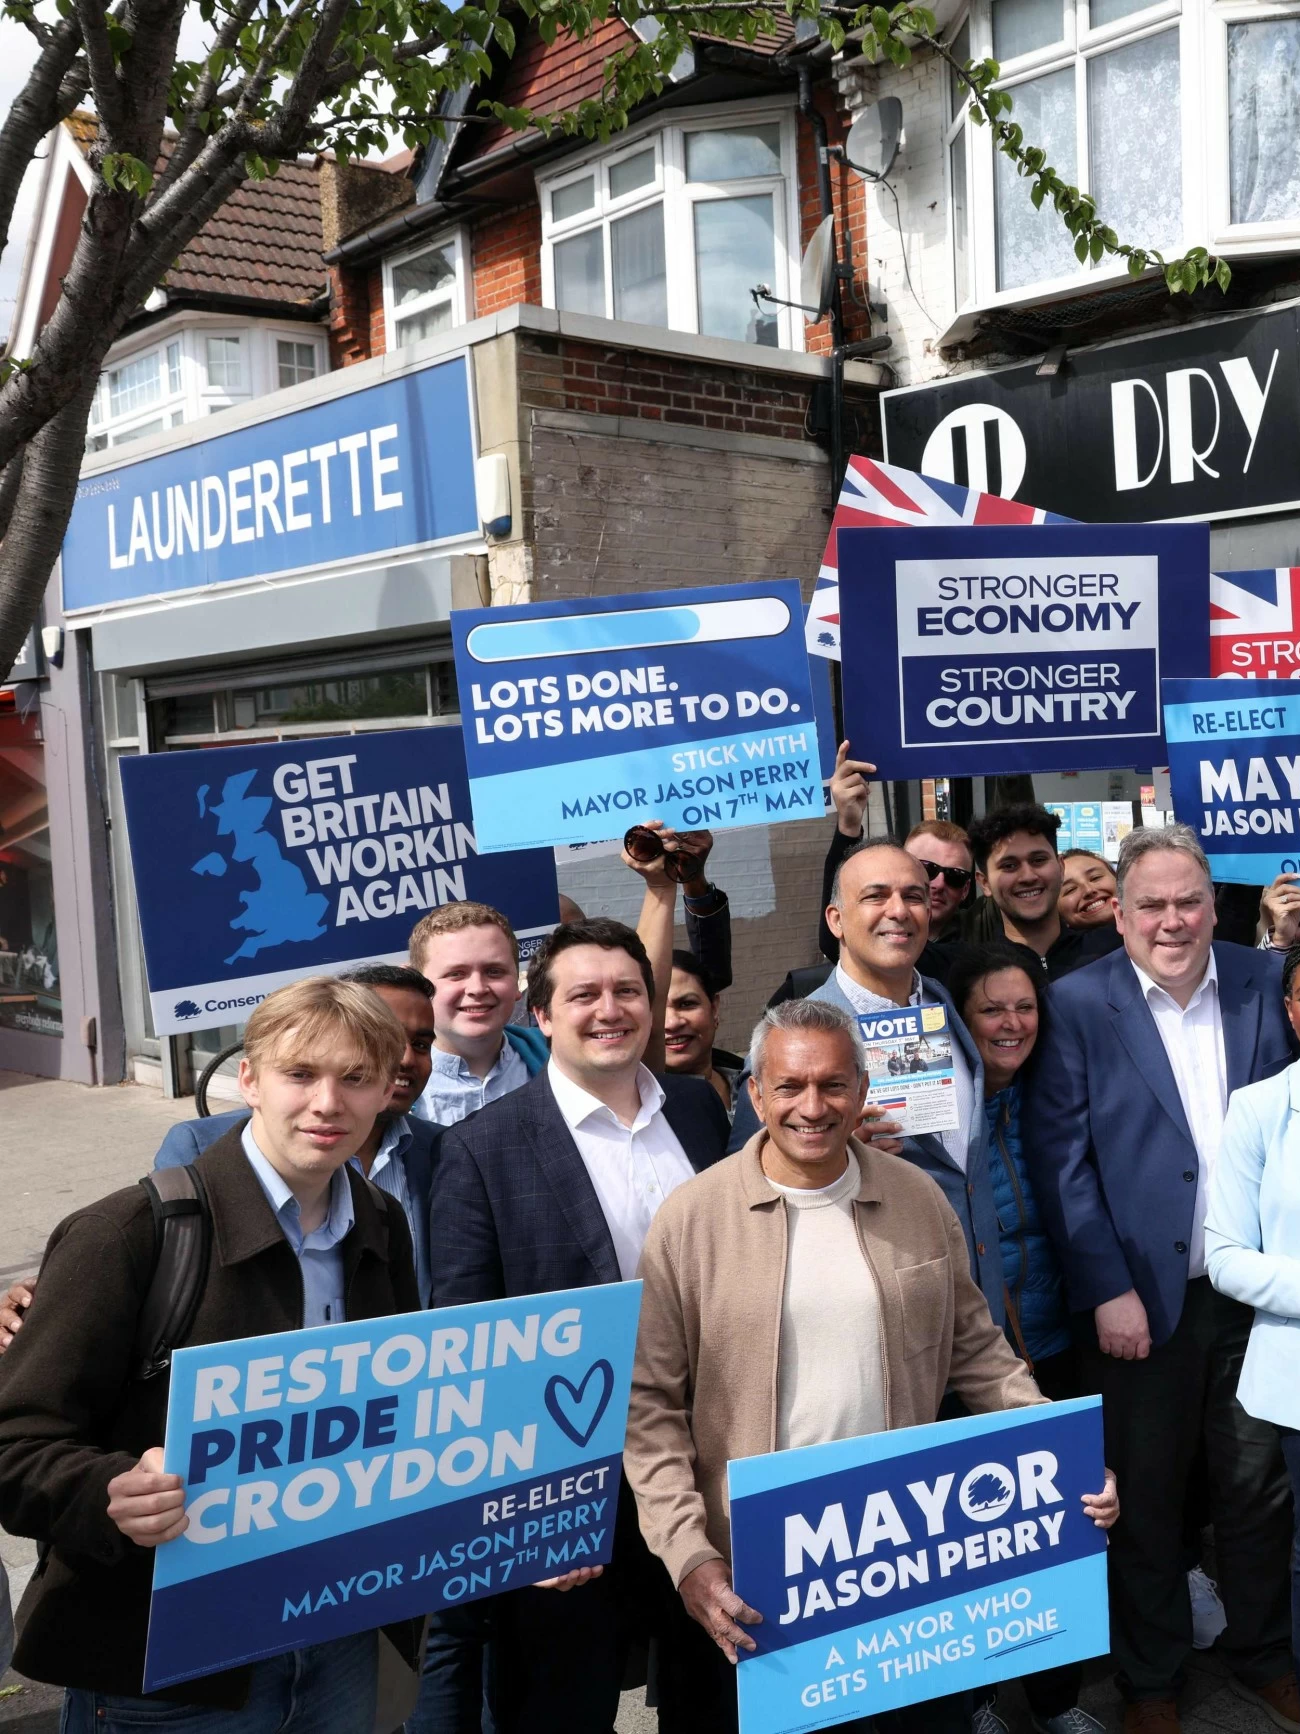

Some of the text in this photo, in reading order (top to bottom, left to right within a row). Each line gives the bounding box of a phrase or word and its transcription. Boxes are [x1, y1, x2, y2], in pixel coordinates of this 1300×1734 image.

[1111, 347, 1280, 492] DRY
[107, 423, 403, 570] LAUNDERETTE
[938, 573, 1119, 601] STRONGER
[917, 601, 1141, 637] ECONOMY
[471, 665, 679, 711] LOTS DONE.
[940, 663, 1121, 693] STRONGER
[475, 687, 801, 744] LOTS MORE TO DO.
[925, 690, 1137, 728] COUNTRY
[1192, 707, 1287, 734] RE-ELECT
[273, 754, 357, 803] GET
[671, 732, 807, 773] STICK WITH
[281, 783, 452, 848] BRITAIN
[561, 759, 811, 820] MAYOR JASON PERRY
[682, 802, 722, 826] ON
[765, 786, 815, 814] MAY
[1200, 808, 1294, 836] JASON
[306, 821, 479, 885] WORKIN
[335, 865, 467, 926] AGAIN
[861, 1016, 917, 1038] VOTE
[192, 1308, 582, 1422] RESTORING
[187, 1378, 486, 1486] PRIDE IN
[183, 1423, 538, 1545] CROYDON
[482, 1466, 610, 1526] RE-ELECT
[784, 1450, 1064, 1578] MAYOR
[281, 1497, 608, 1623] MAYOR JASON PERRY
[442, 1566, 492, 1602] ON
[545, 1528, 606, 1569] MAY
[779, 1510, 1065, 1625] JASON PERRY
[800, 1608, 1059, 1708] GETS THINGS DONE
[824, 1587, 1032, 1671] A MAYOR WHO
